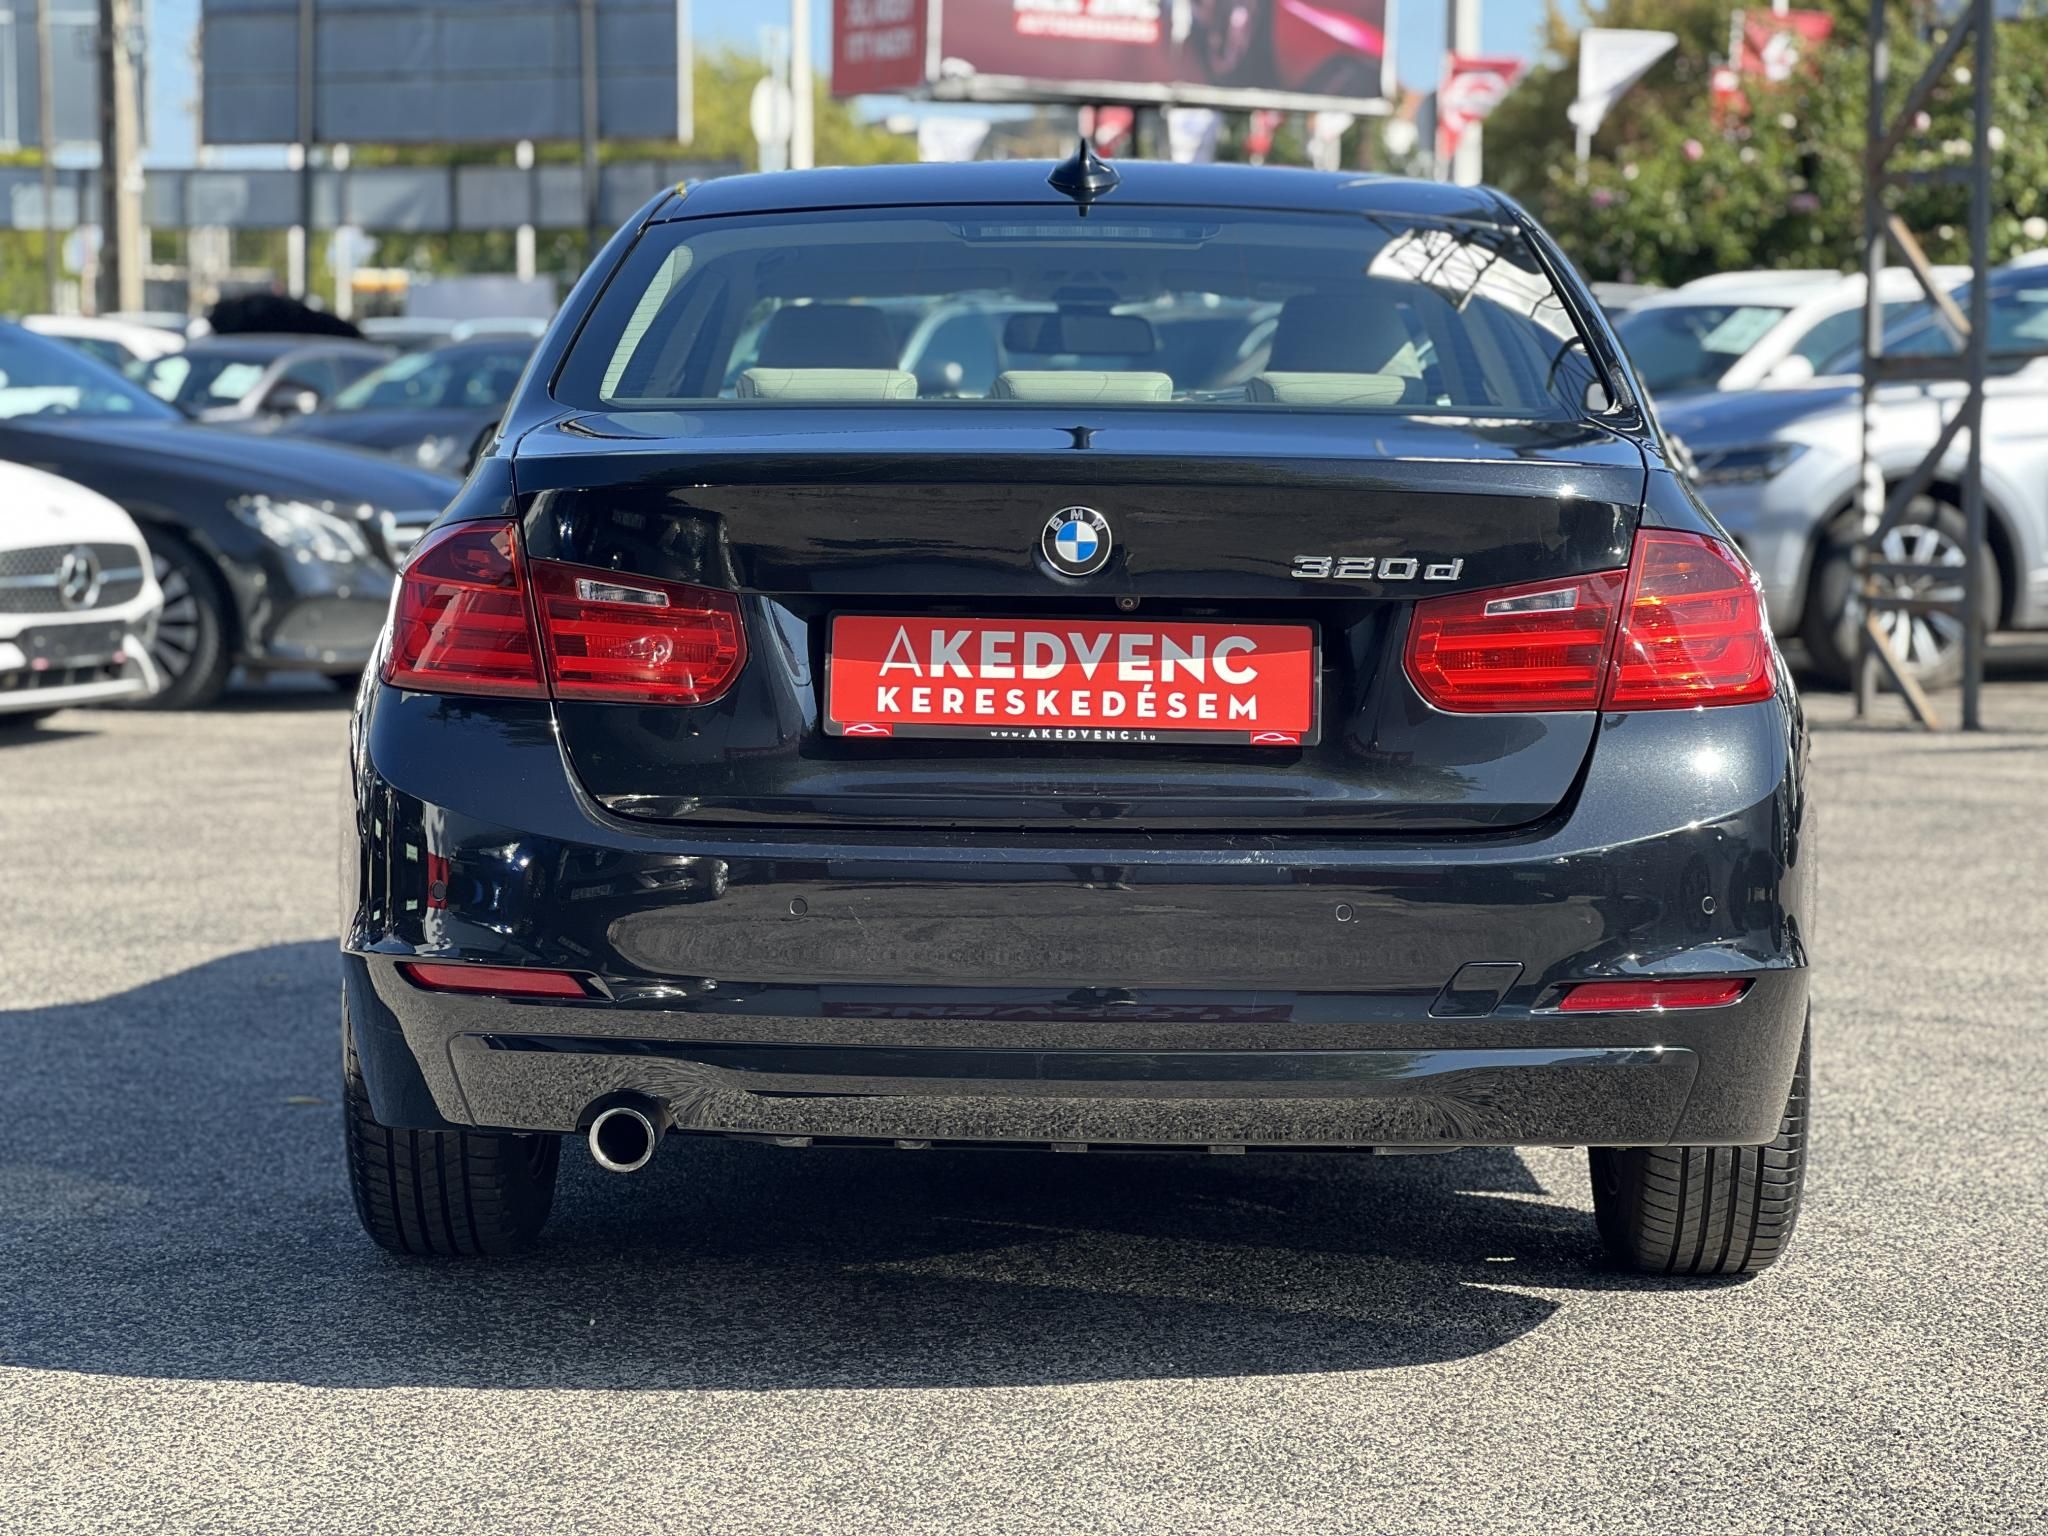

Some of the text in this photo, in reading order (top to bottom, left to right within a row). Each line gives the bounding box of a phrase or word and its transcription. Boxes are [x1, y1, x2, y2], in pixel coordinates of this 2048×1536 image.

[1049, 509, 1106, 531] BMW
[1291, 555, 1465, 581] 320d
[879, 625, 1259, 685] AKEDVENC
[877, 684, 1258, 721] KERESKEDÉSEM
[990, 728, 1156, 742] www.AKEDVENC.hu
